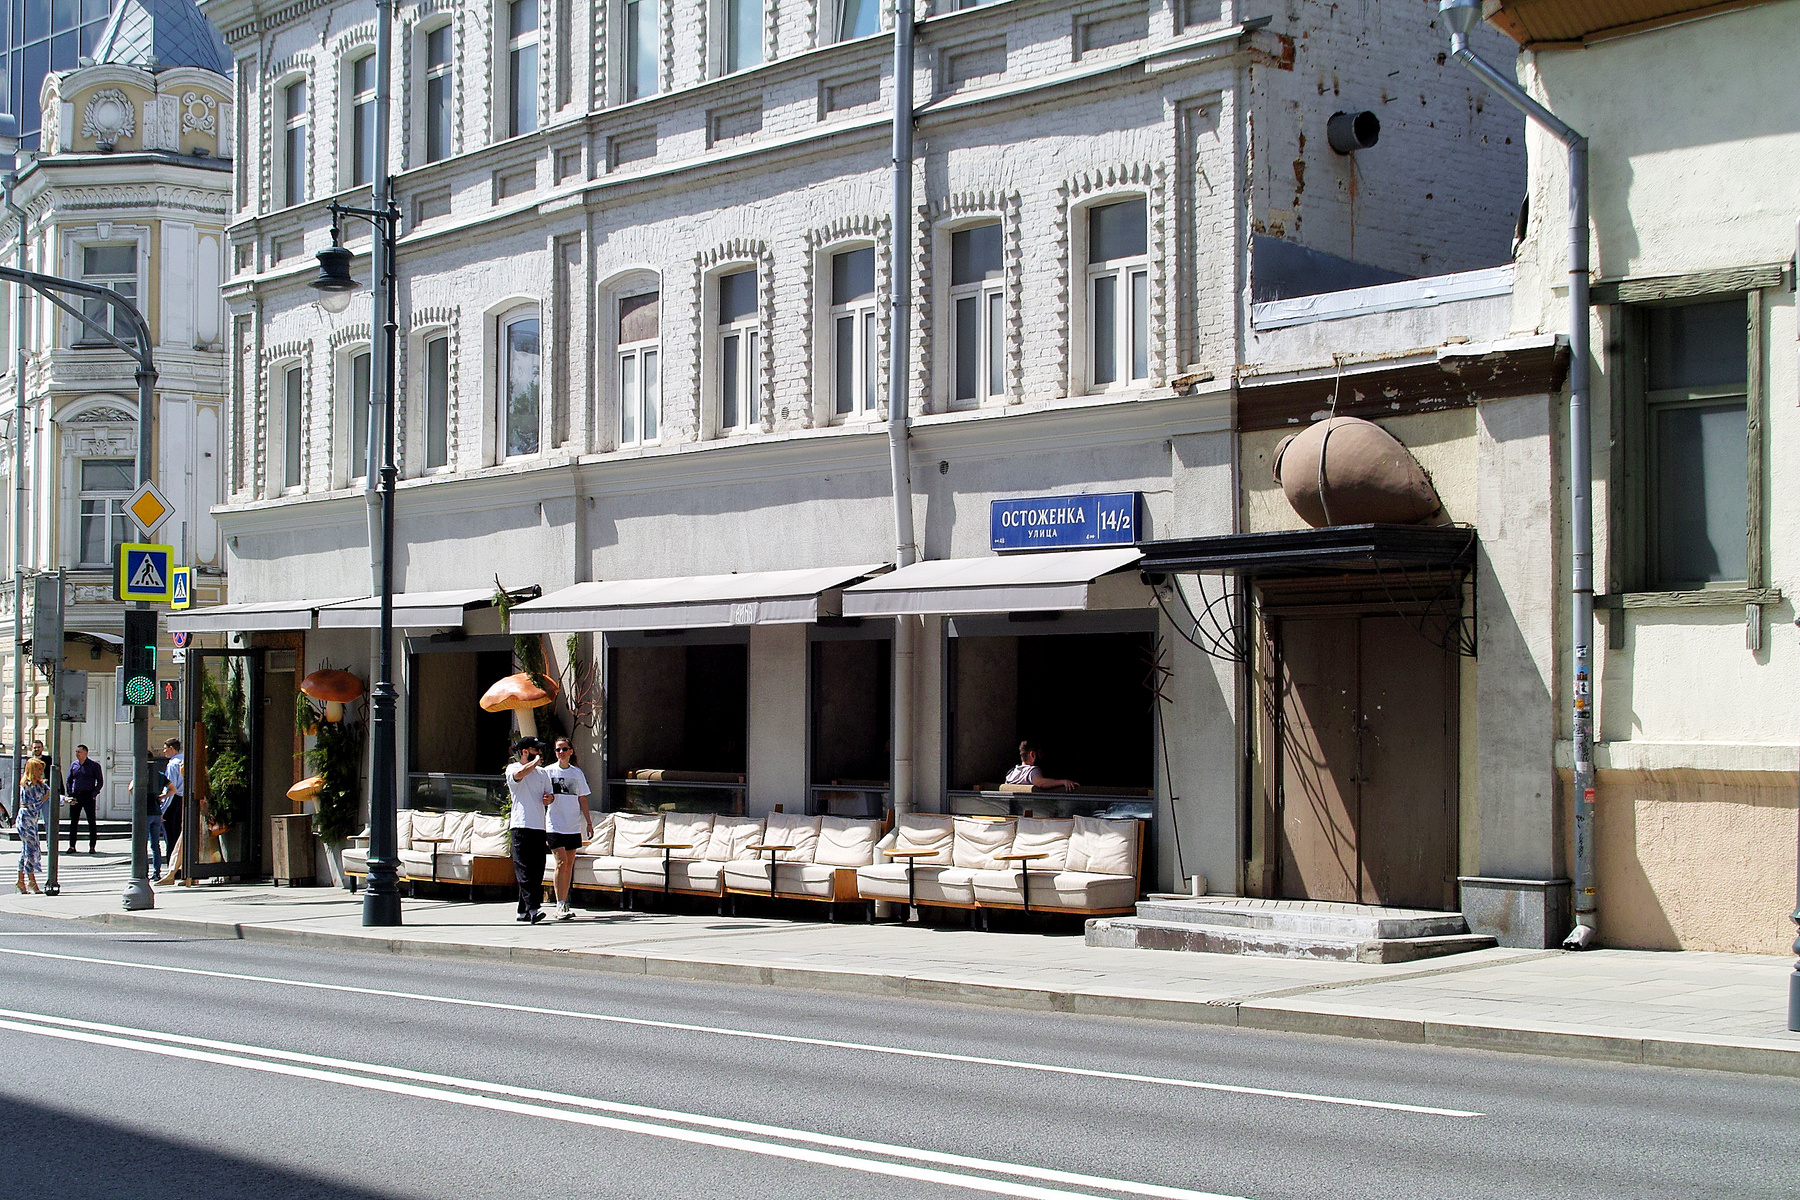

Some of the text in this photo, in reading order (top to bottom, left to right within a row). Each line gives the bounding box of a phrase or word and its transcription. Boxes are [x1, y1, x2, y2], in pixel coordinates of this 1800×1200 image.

[1001, 506, 1086, 527] ОСТОЖЕНКА
[1100, 508, 1130, 532] 14/2
[1028, 528, 1058, 539] УЛИЦА
